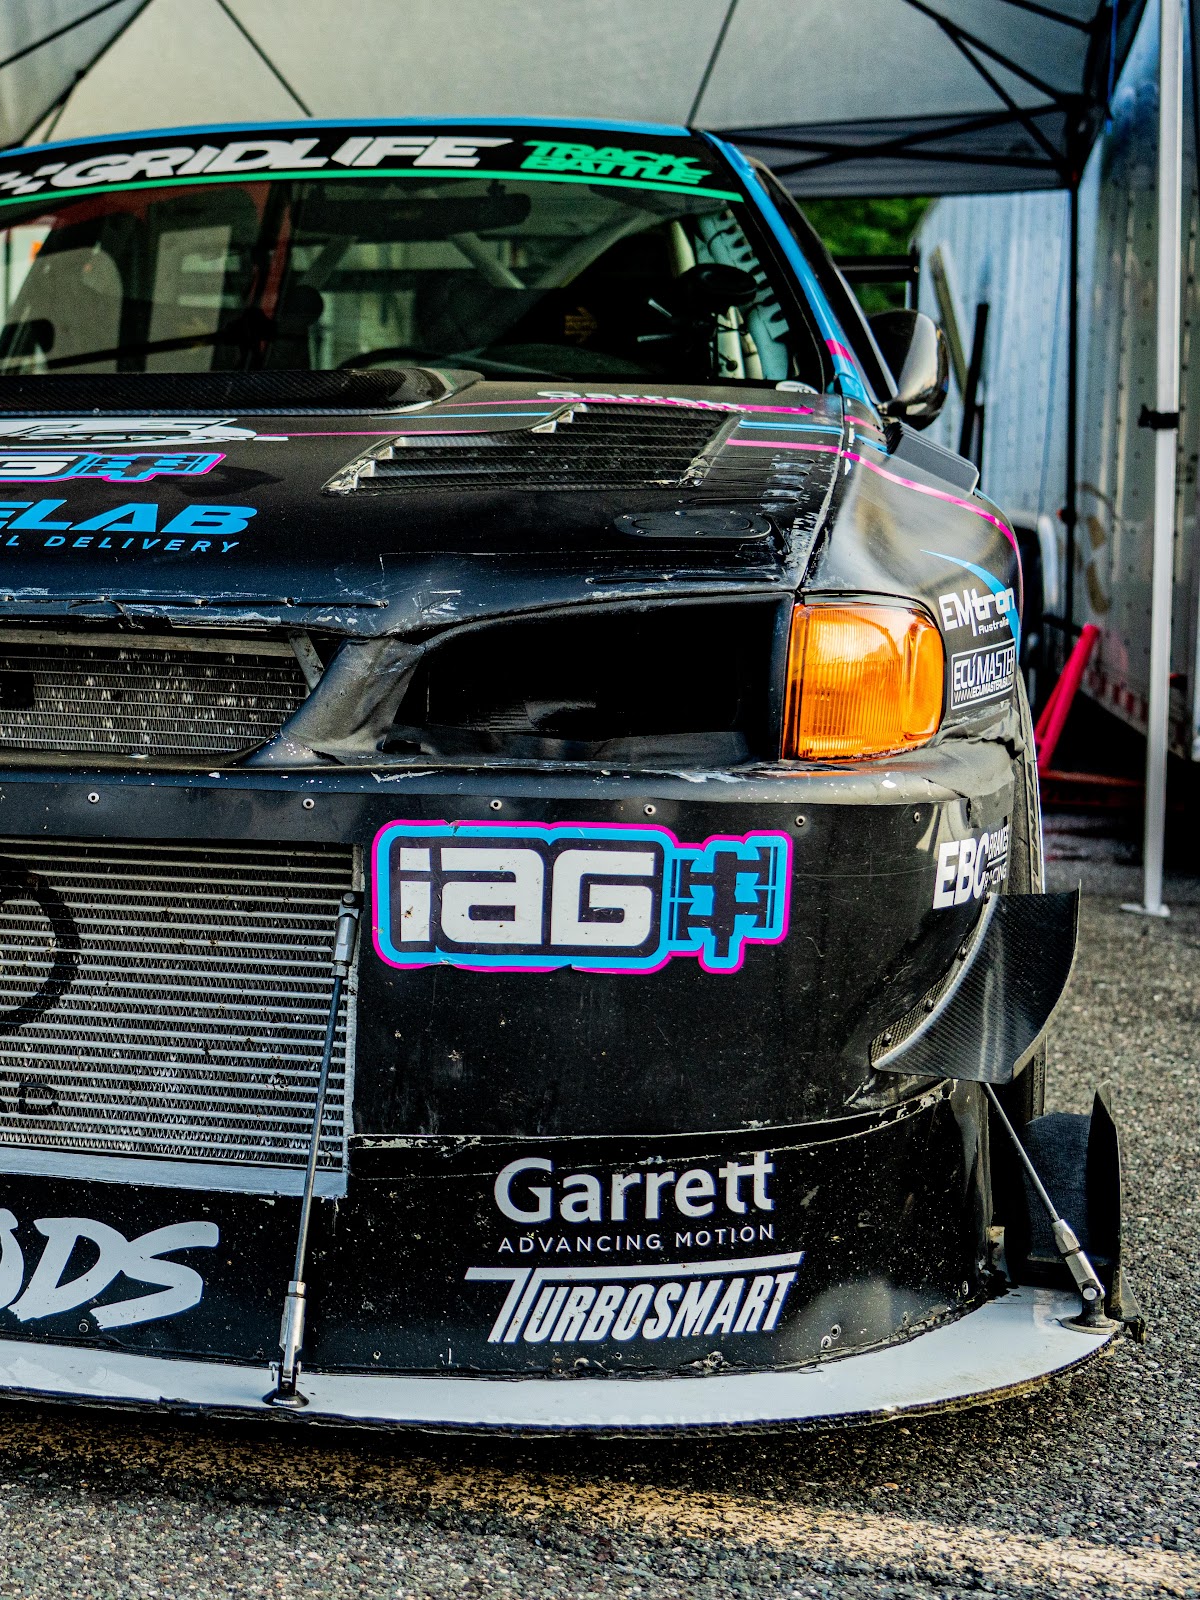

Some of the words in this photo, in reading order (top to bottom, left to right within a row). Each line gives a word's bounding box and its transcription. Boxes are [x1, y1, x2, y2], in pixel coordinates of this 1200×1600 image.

[46, 136, 514, 187] GRIDLIFE
[520, 156, 712, 185] BATTLE
[522, 139, 700, 169] TRACK
[44, 536, 240, 554] DELIVERY
[932, 832, 989, 909] EBC
[494, 1152, 774, 1223] Garrett
[498, 1231, 662, 1253] ADVANCING
[675, 1224, 775, 1248] MOTION
[465, 1251, 806, 1345] TURBOSMART
